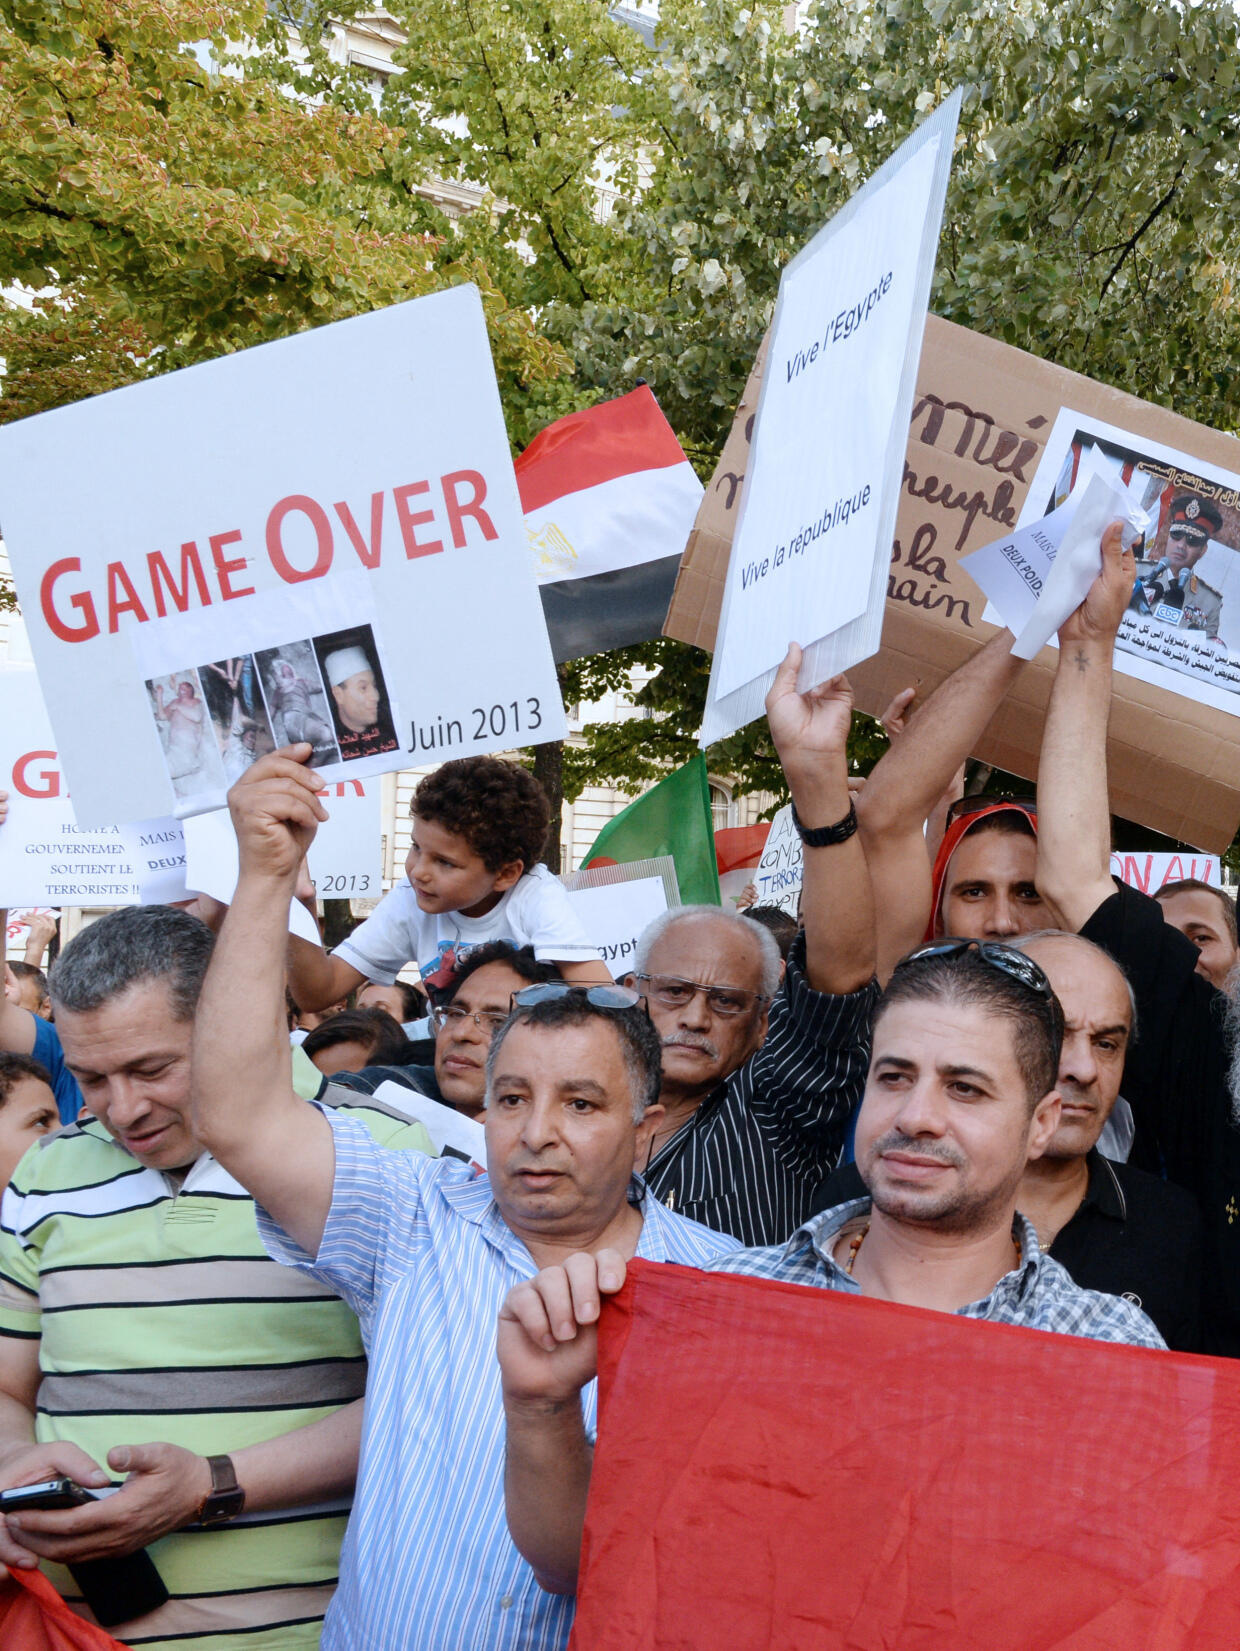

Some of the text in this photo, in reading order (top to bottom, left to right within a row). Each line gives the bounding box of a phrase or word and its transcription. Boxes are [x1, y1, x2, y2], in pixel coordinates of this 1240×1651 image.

[787, 271, 893, 384] Vive l'Egypte
[741, 557, 769, 591] Vive
[772, 545, 786, 570] la
[788, 484, 871, 559] république
[40, 468, 499, 644] GAME OVER
[904, 523, 952, 583] la
[1003, 544, 1027, 567] DEUX
[1157, 606, 1179, 621] cbc
[407, 697, 543, 754] Juin 2013
[139, 831, 177, 847] MAIS
[147, 855, 187, 870] DEUX
[760, 838, 803, 869] COMB
[51, 864, 115, 874] SOUTIENT
[46, 884, 128, 895] TERRORISTES
[322, 875, 370, 892] 2013
[597, 937, 638, 960] gypt
